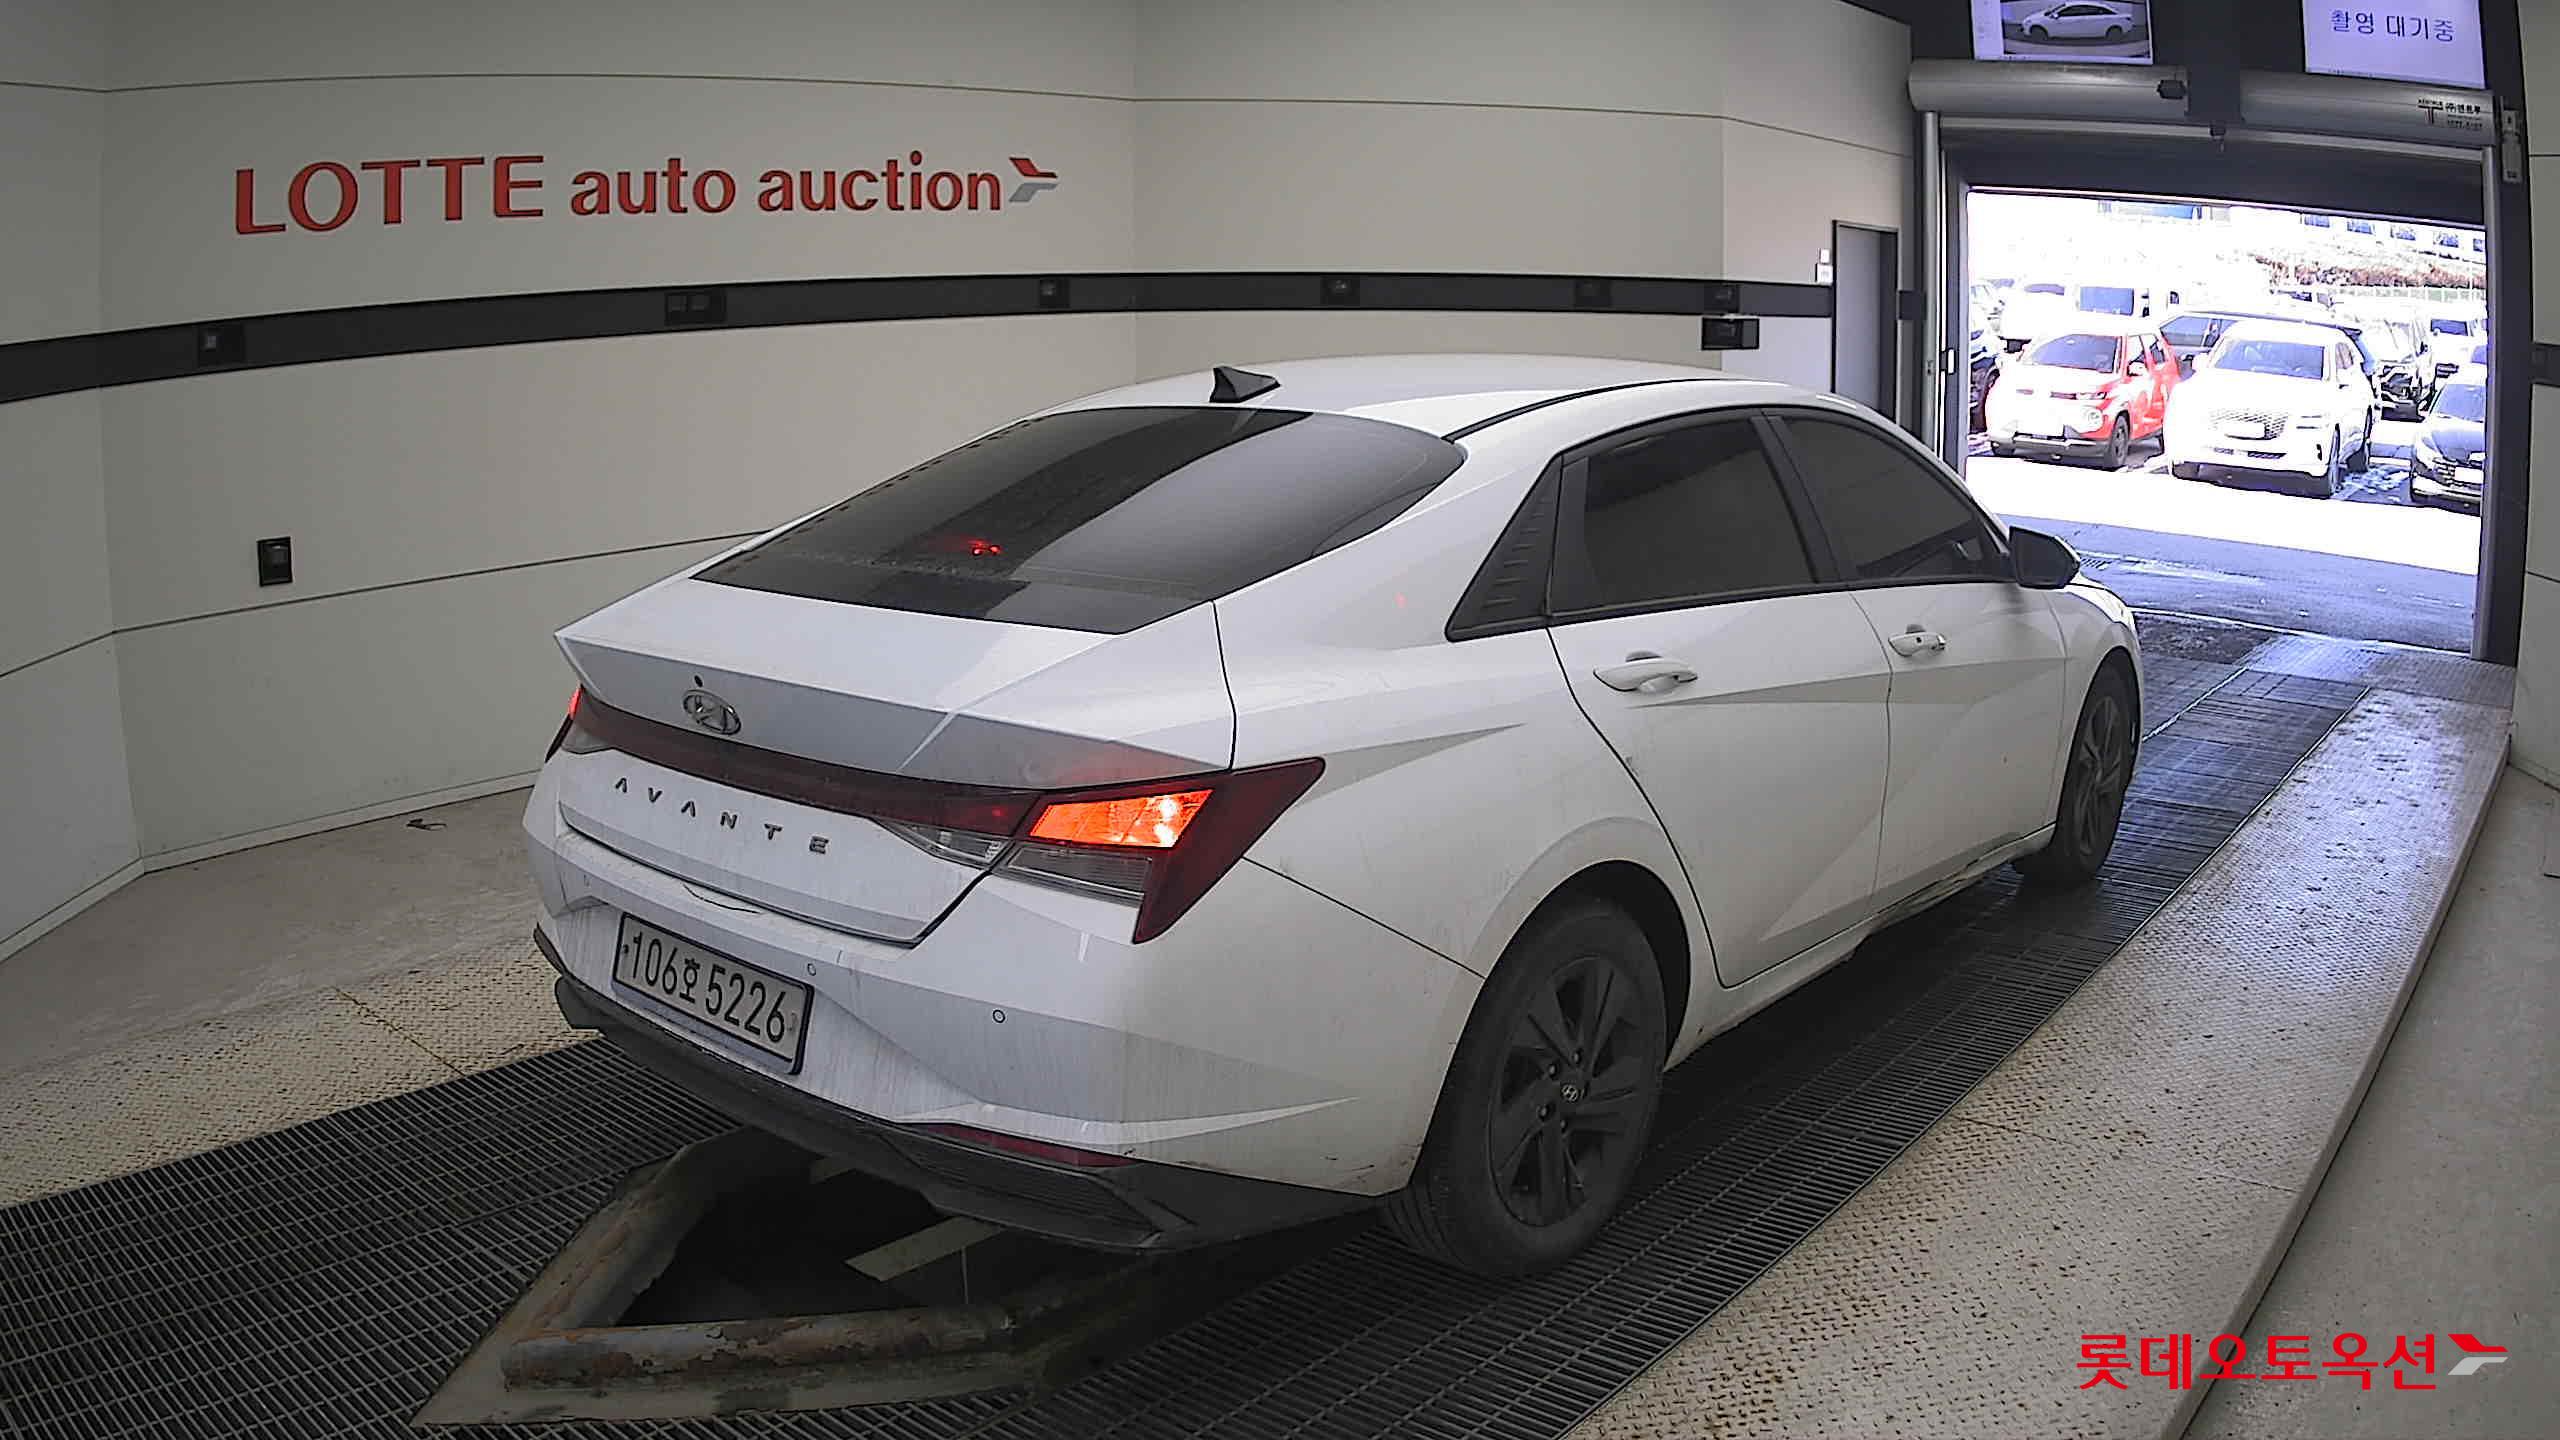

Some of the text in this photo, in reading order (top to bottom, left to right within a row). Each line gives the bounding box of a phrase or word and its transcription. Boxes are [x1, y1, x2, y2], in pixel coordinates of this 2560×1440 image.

[2331, 9, 2455, 43] 촬영 대기중
[236, 154, 1002, 233] LOTTE auto auction
[614, 776, 830, 856] AVANTE
